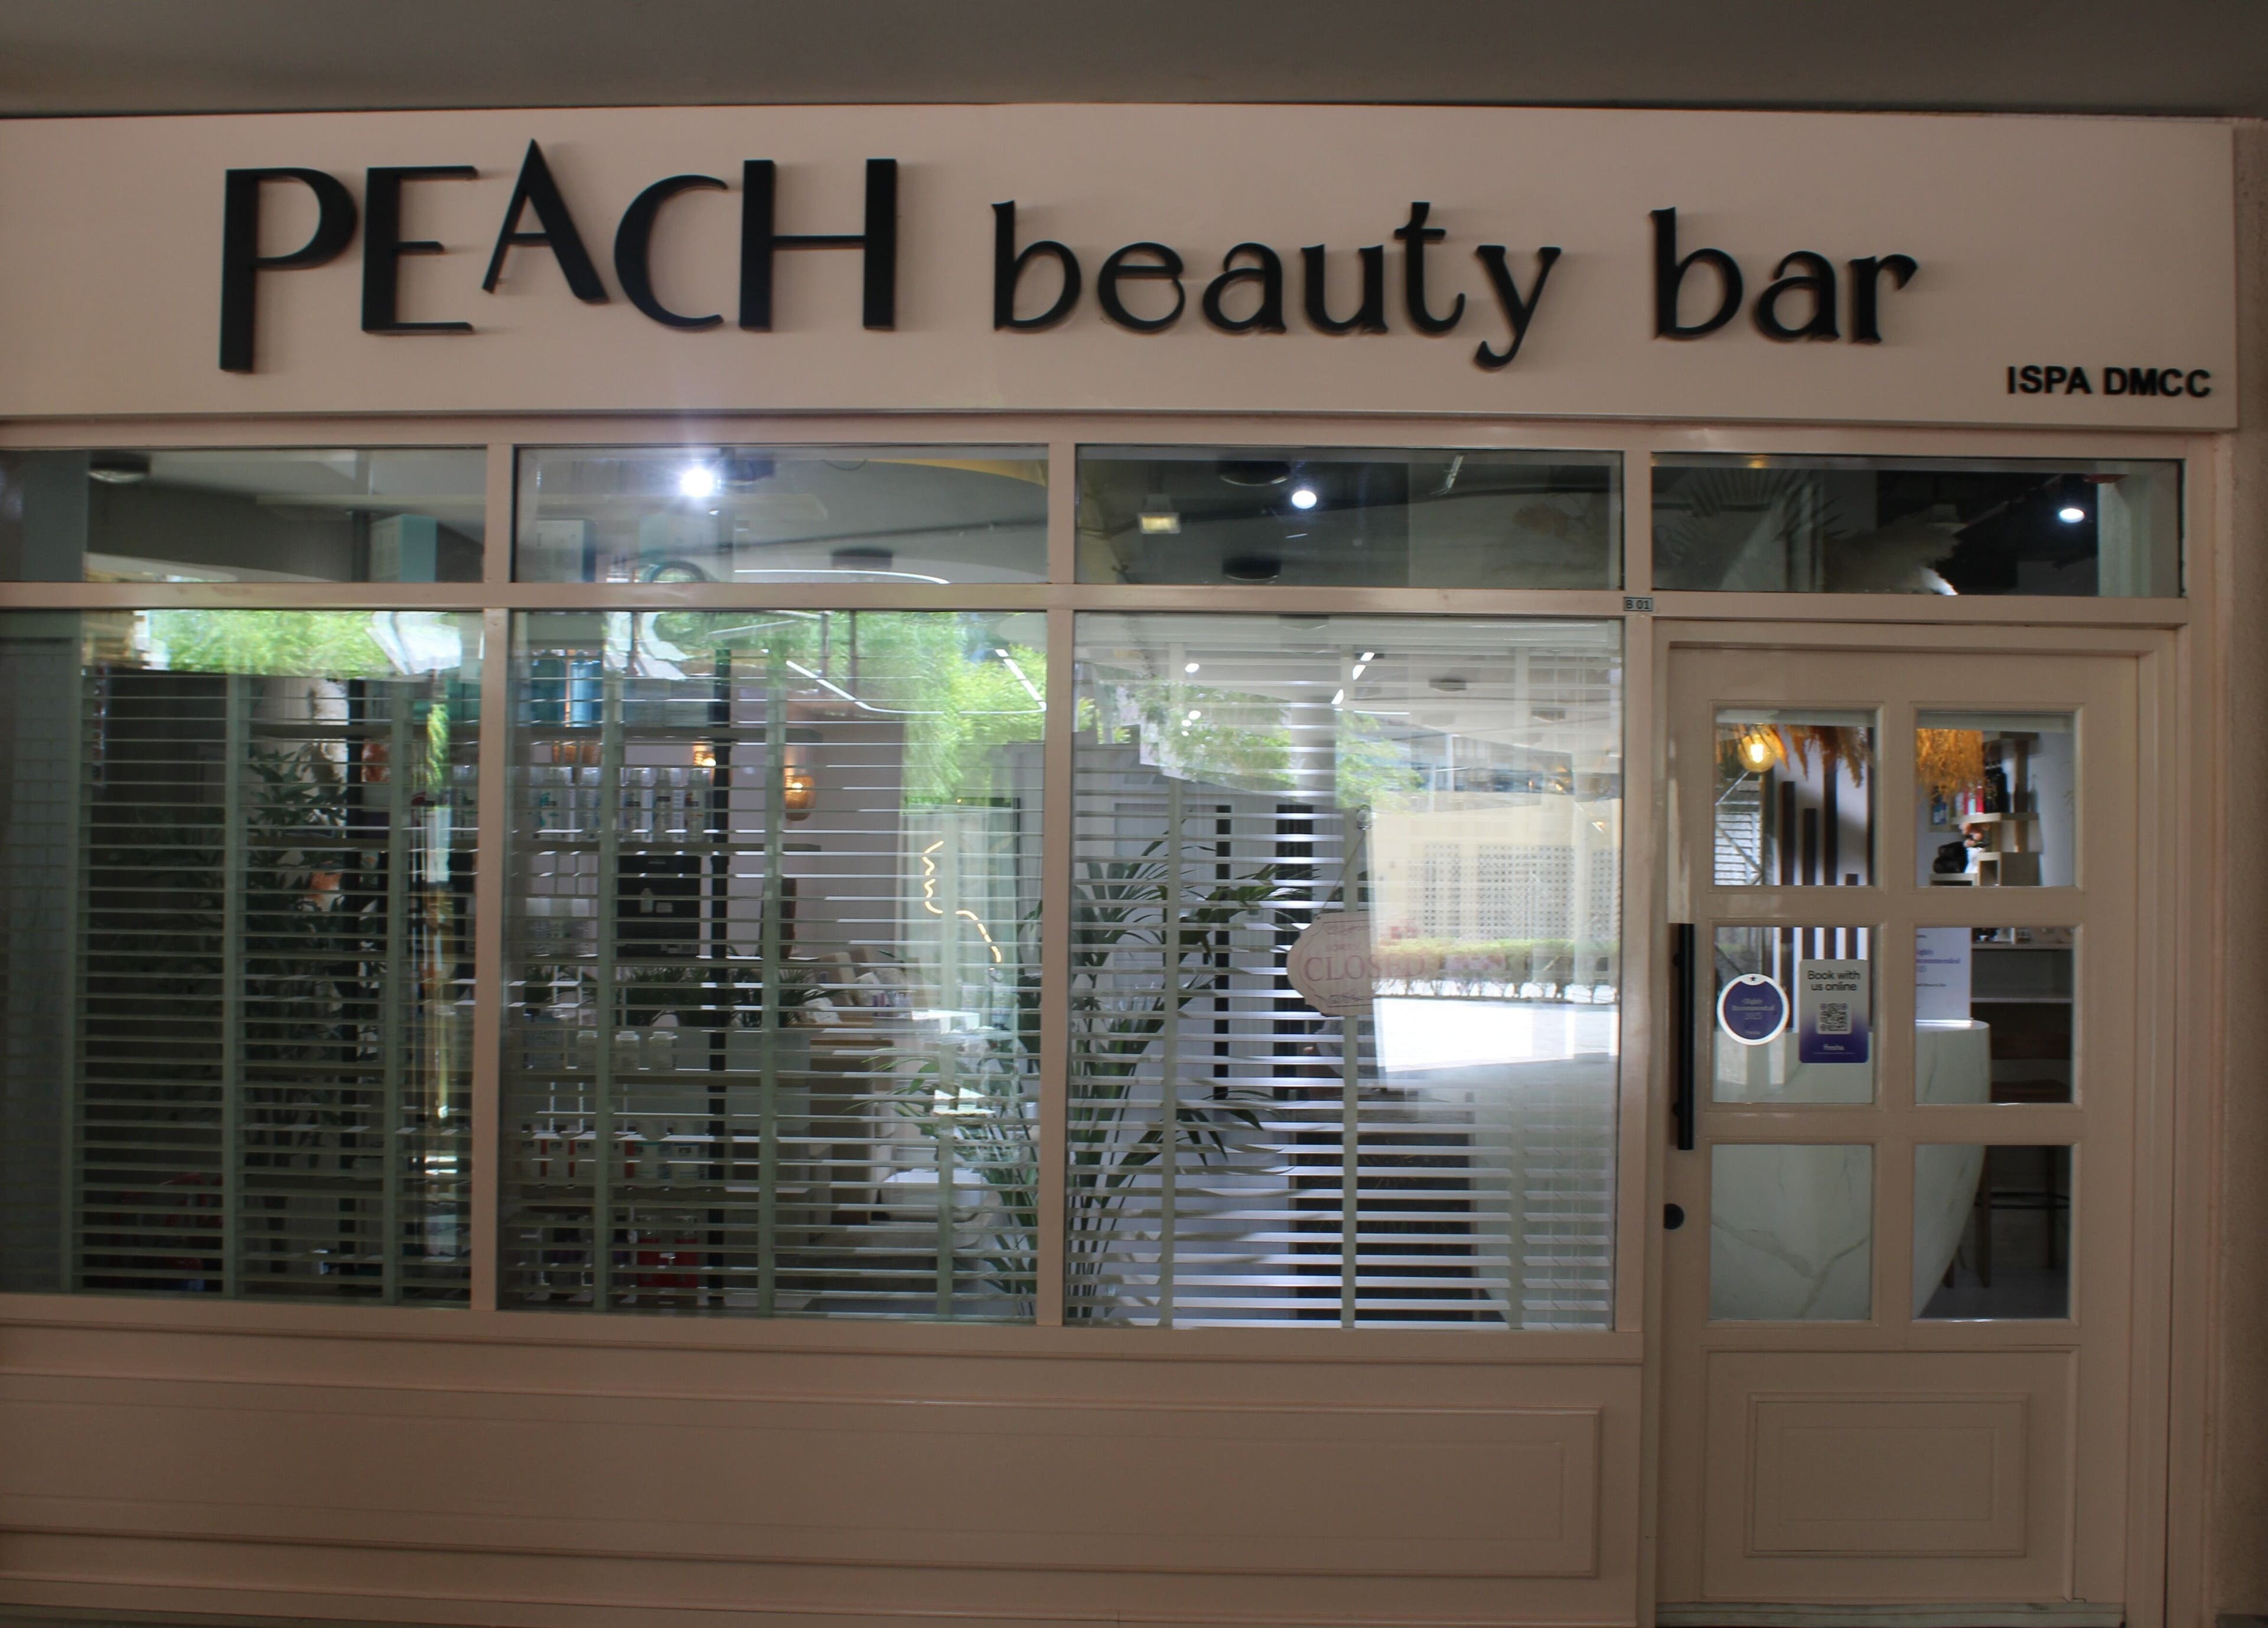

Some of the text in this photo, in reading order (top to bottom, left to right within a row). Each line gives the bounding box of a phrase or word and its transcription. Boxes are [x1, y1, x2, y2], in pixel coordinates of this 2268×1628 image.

[219, 139, 1920, 375] PEACH beauty bar
[2006, 364, 2212, 398] ISPA DMCC
[1636, 600, 1650, 610] 01
[1807, 969, 1861, 980] Book with
[1824, 981, 1858, 991] online
